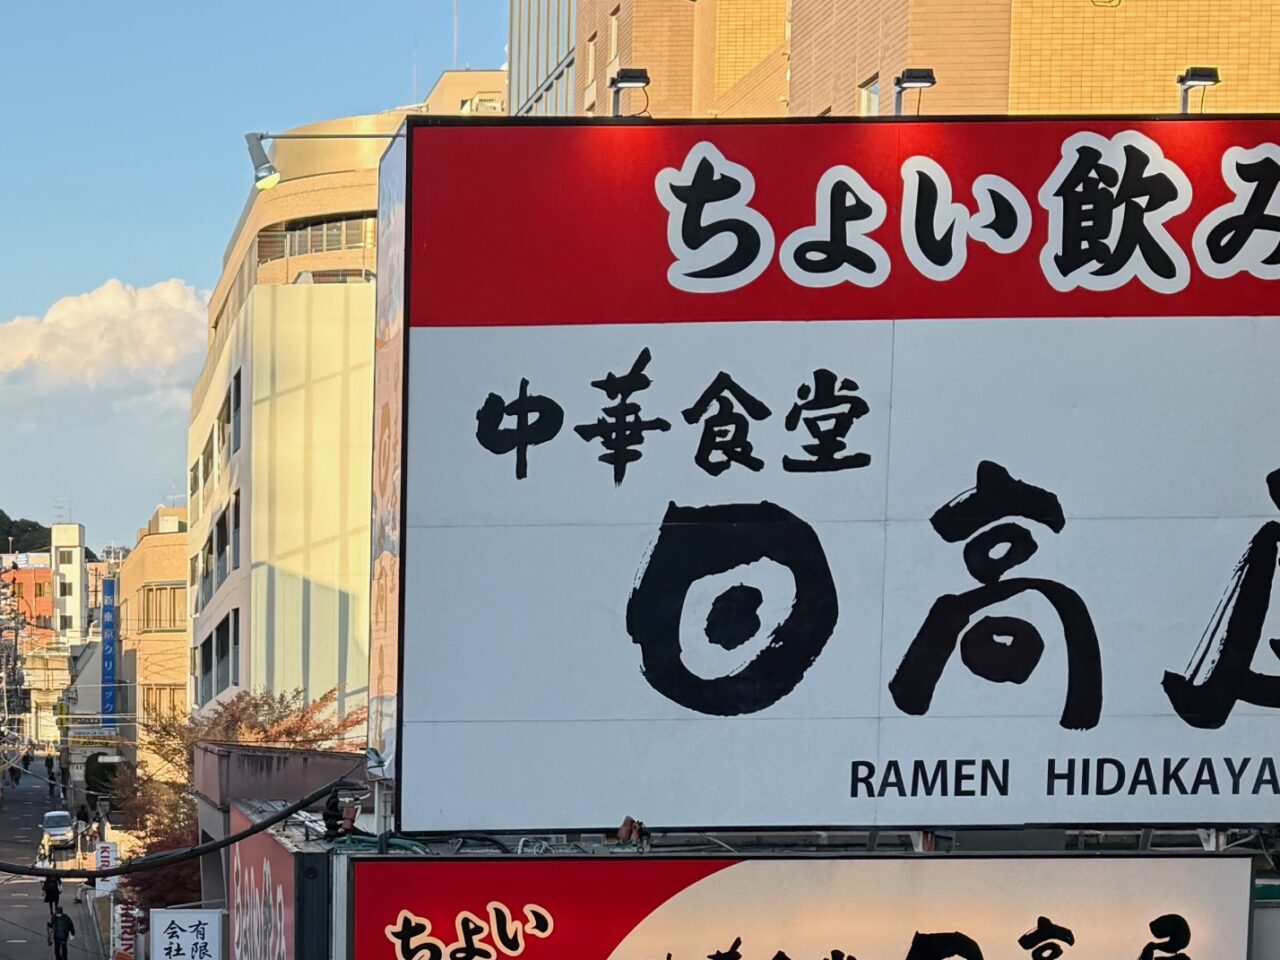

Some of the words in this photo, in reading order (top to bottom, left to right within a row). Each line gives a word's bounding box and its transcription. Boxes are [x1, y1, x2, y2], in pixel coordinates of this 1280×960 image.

[654, 131, 1280, 294] ちょい飲み
[475, 347, 871, 487] 中華食堂
[849, 758, 1010, 798] RAMEN
[1046, 757, 1280, 796] HIDAKAYA
[100, 845, 110, 882] KIRN
